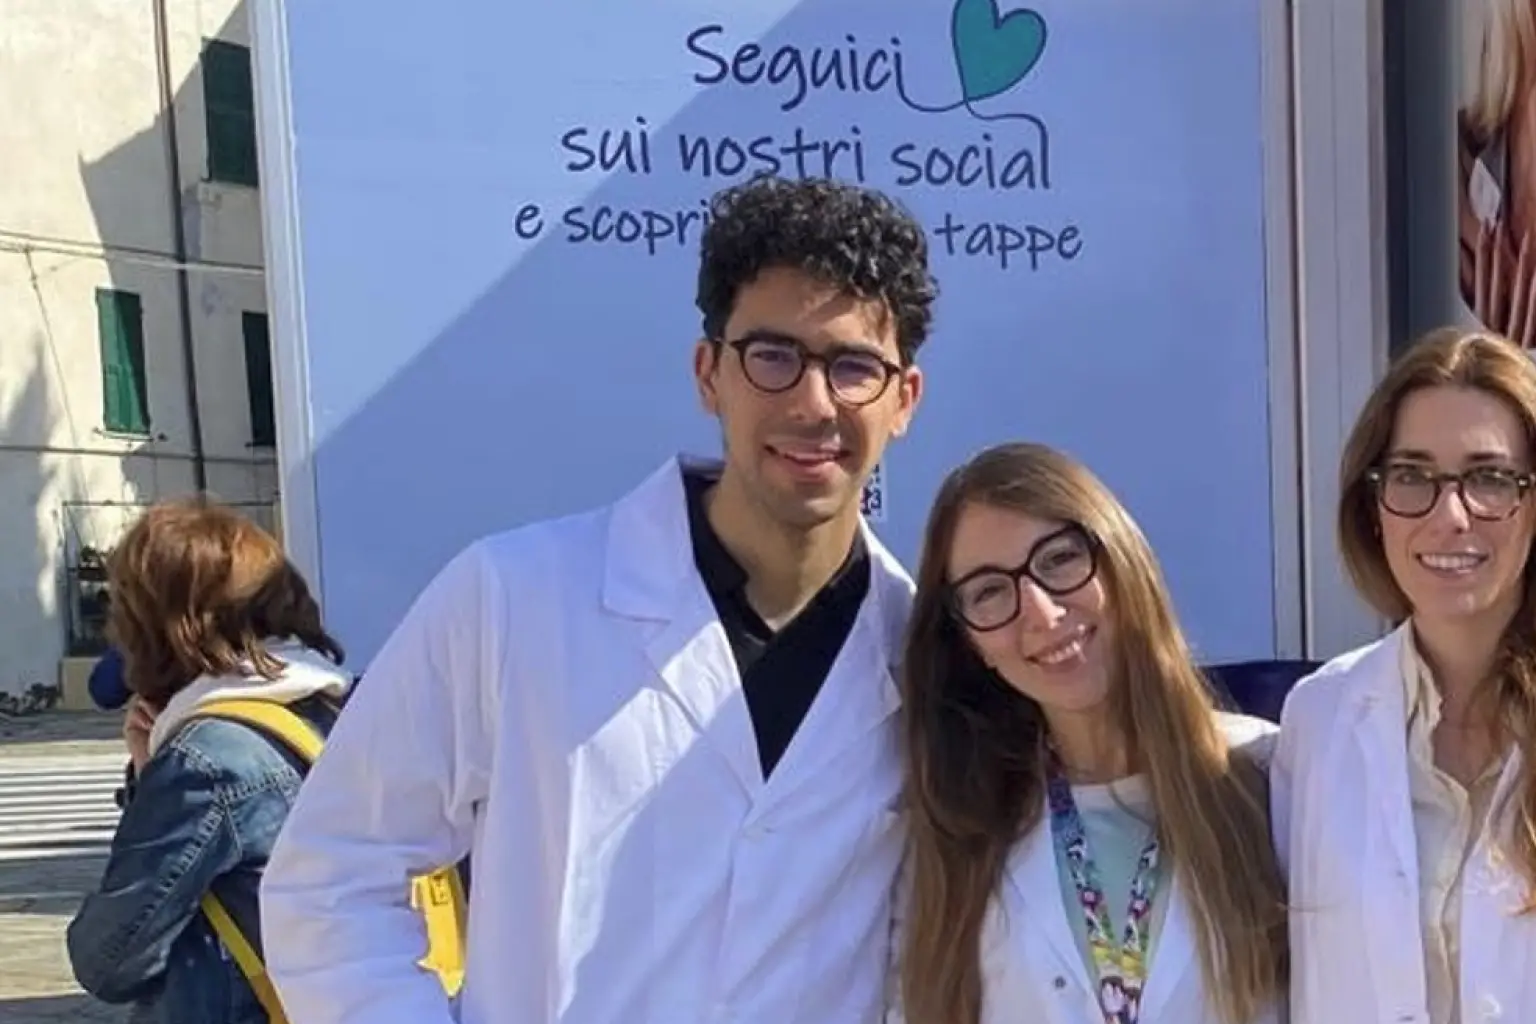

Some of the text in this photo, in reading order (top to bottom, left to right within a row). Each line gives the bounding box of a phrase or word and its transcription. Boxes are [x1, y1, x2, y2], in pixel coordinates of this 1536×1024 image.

[685, 24, 903, 112] Seguici
[560, 116, 1052, 190] sui nostri social
[514, 204, 544, 240] e
[932, 212, 1084, 273] tappe
